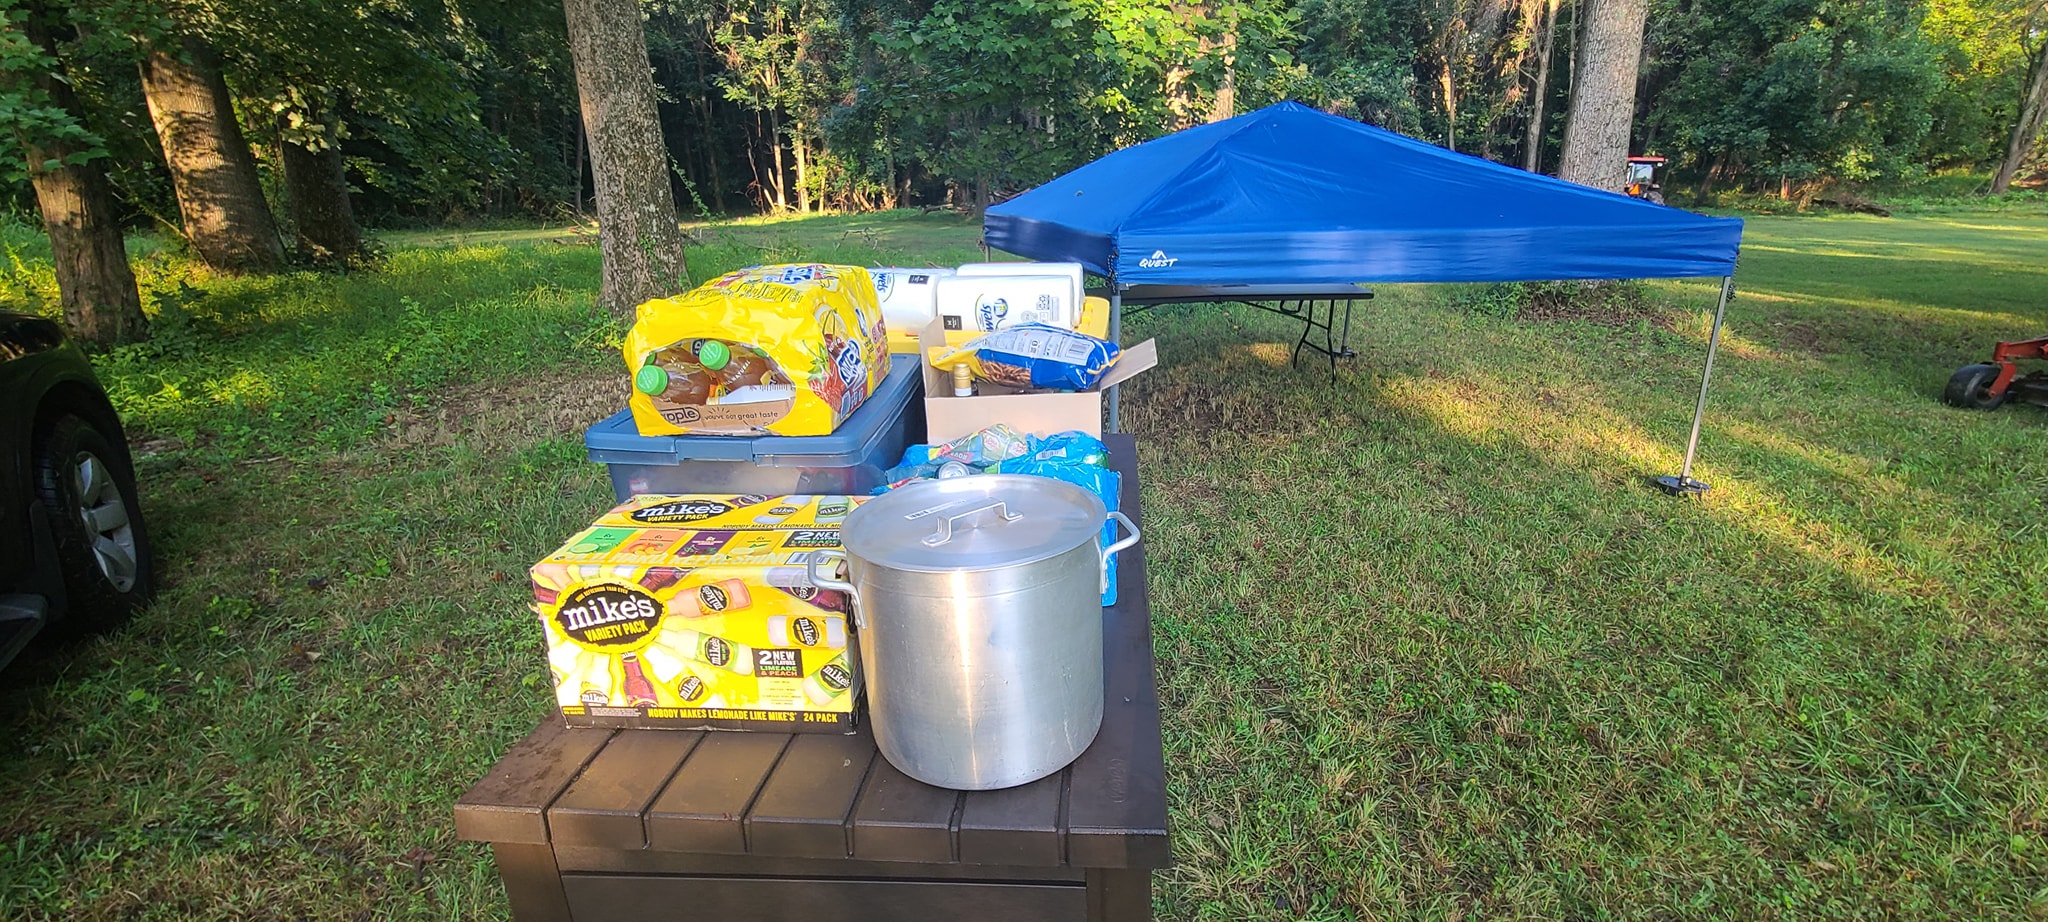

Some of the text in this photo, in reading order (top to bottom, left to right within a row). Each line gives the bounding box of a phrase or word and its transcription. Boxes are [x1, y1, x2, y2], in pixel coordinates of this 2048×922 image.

[1138, 258, 1178, 269] QUEST
[738, 412, 758, 422] great
[760, 411, 778, 419] taste
[647, 513, 709, 523] VARIETY PACK
[794, 531, 815, 540] 2
[563, 595, 656, 631] mike's
[584, 620, 649, 643] VARIETY PACK
[799, 617, 815, 646] mike's
[758, 650, 795, 665] 2 NEW
[647, 708, 678, 719] NOBODY
[680, 709, 707, 719] MAKES
[708, 709, 748, 720] LEMONADE
[749, 711, 767, 720] LIKE
[803, 712, 814, 722] 24
[816, 713, 838, 723] PACK
